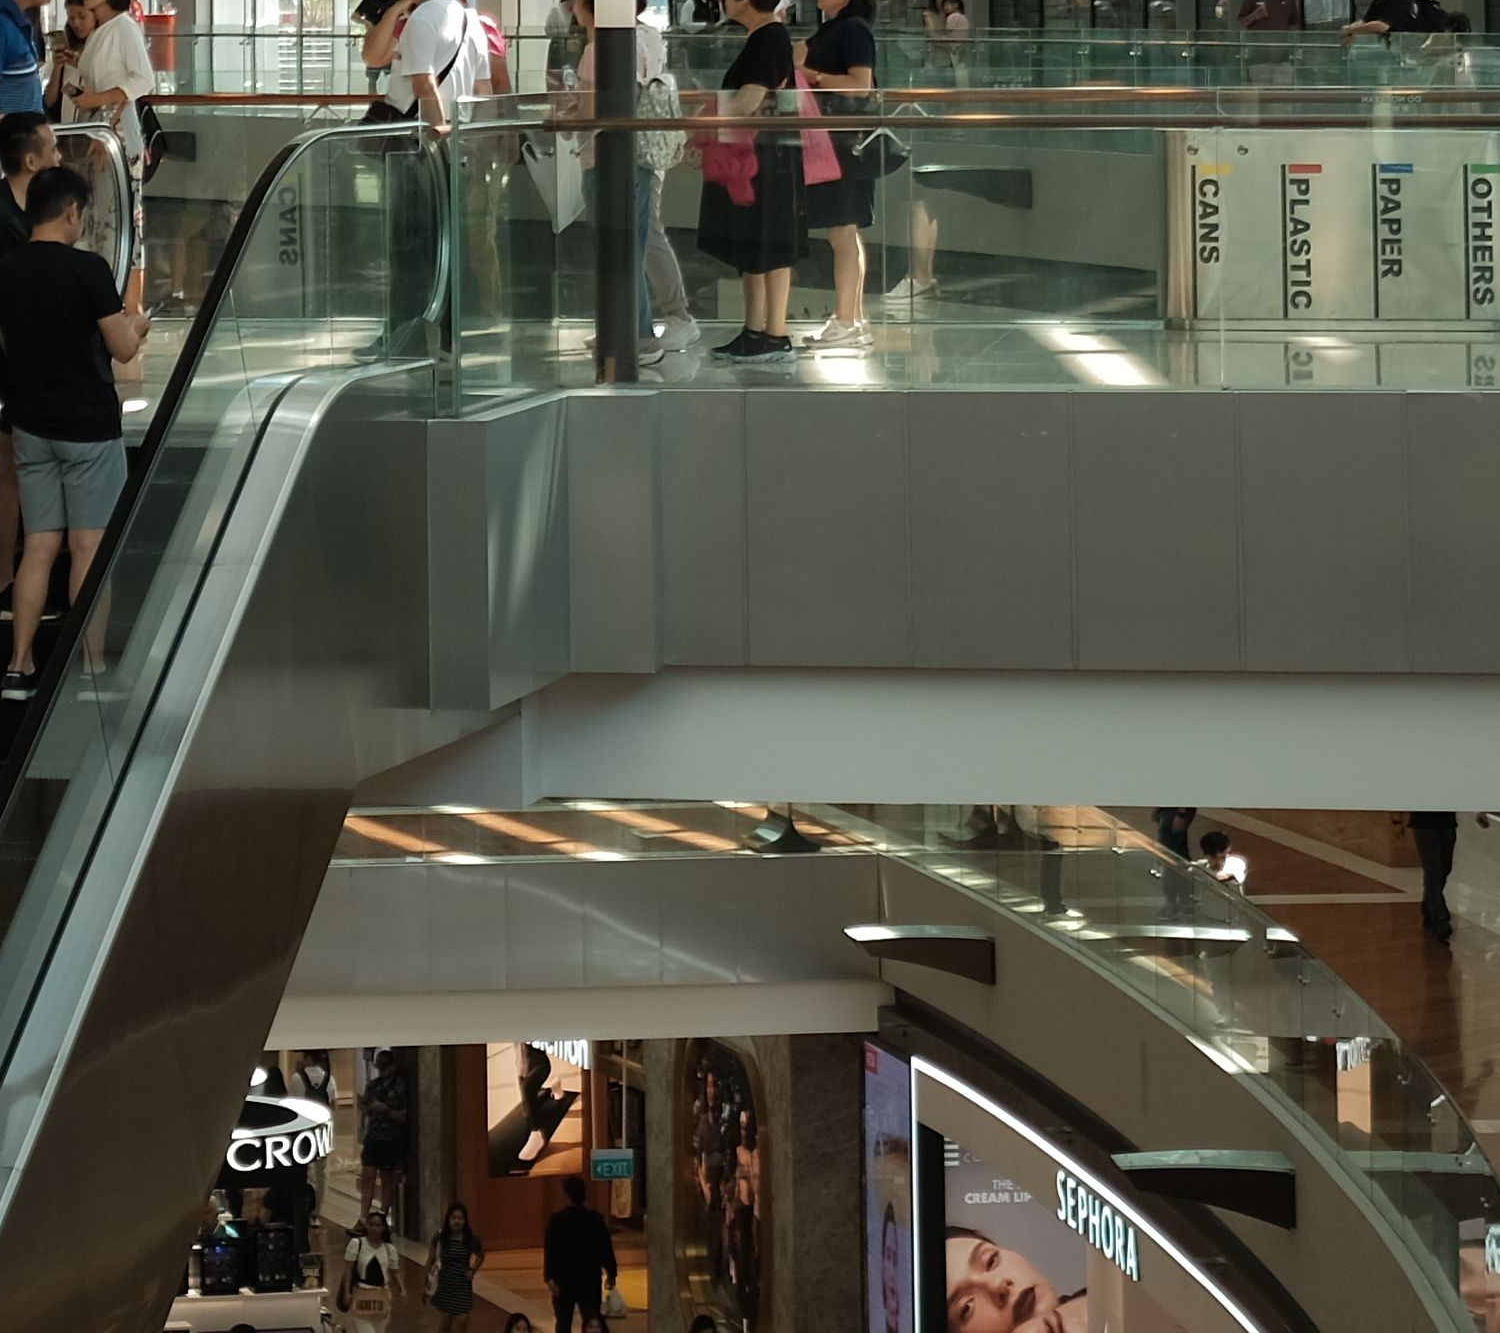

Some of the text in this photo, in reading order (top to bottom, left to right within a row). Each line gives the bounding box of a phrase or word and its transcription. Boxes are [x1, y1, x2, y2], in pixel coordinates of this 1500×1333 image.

[1197, 177, 1221, 265] CANS
[1288, 177, 1313, 311] PLASTIC
[1378, 177, 1404, 280] PAPER
[1469, 177, 1496, 307] OTHERS
[602, 1161, 629, 1176] EXIT
[964, 1191, 1011, 1204] CREAM
[991, 1179, 1014, 1190] THE
[1055, 1169, 1141, 1282] SEPHORA
